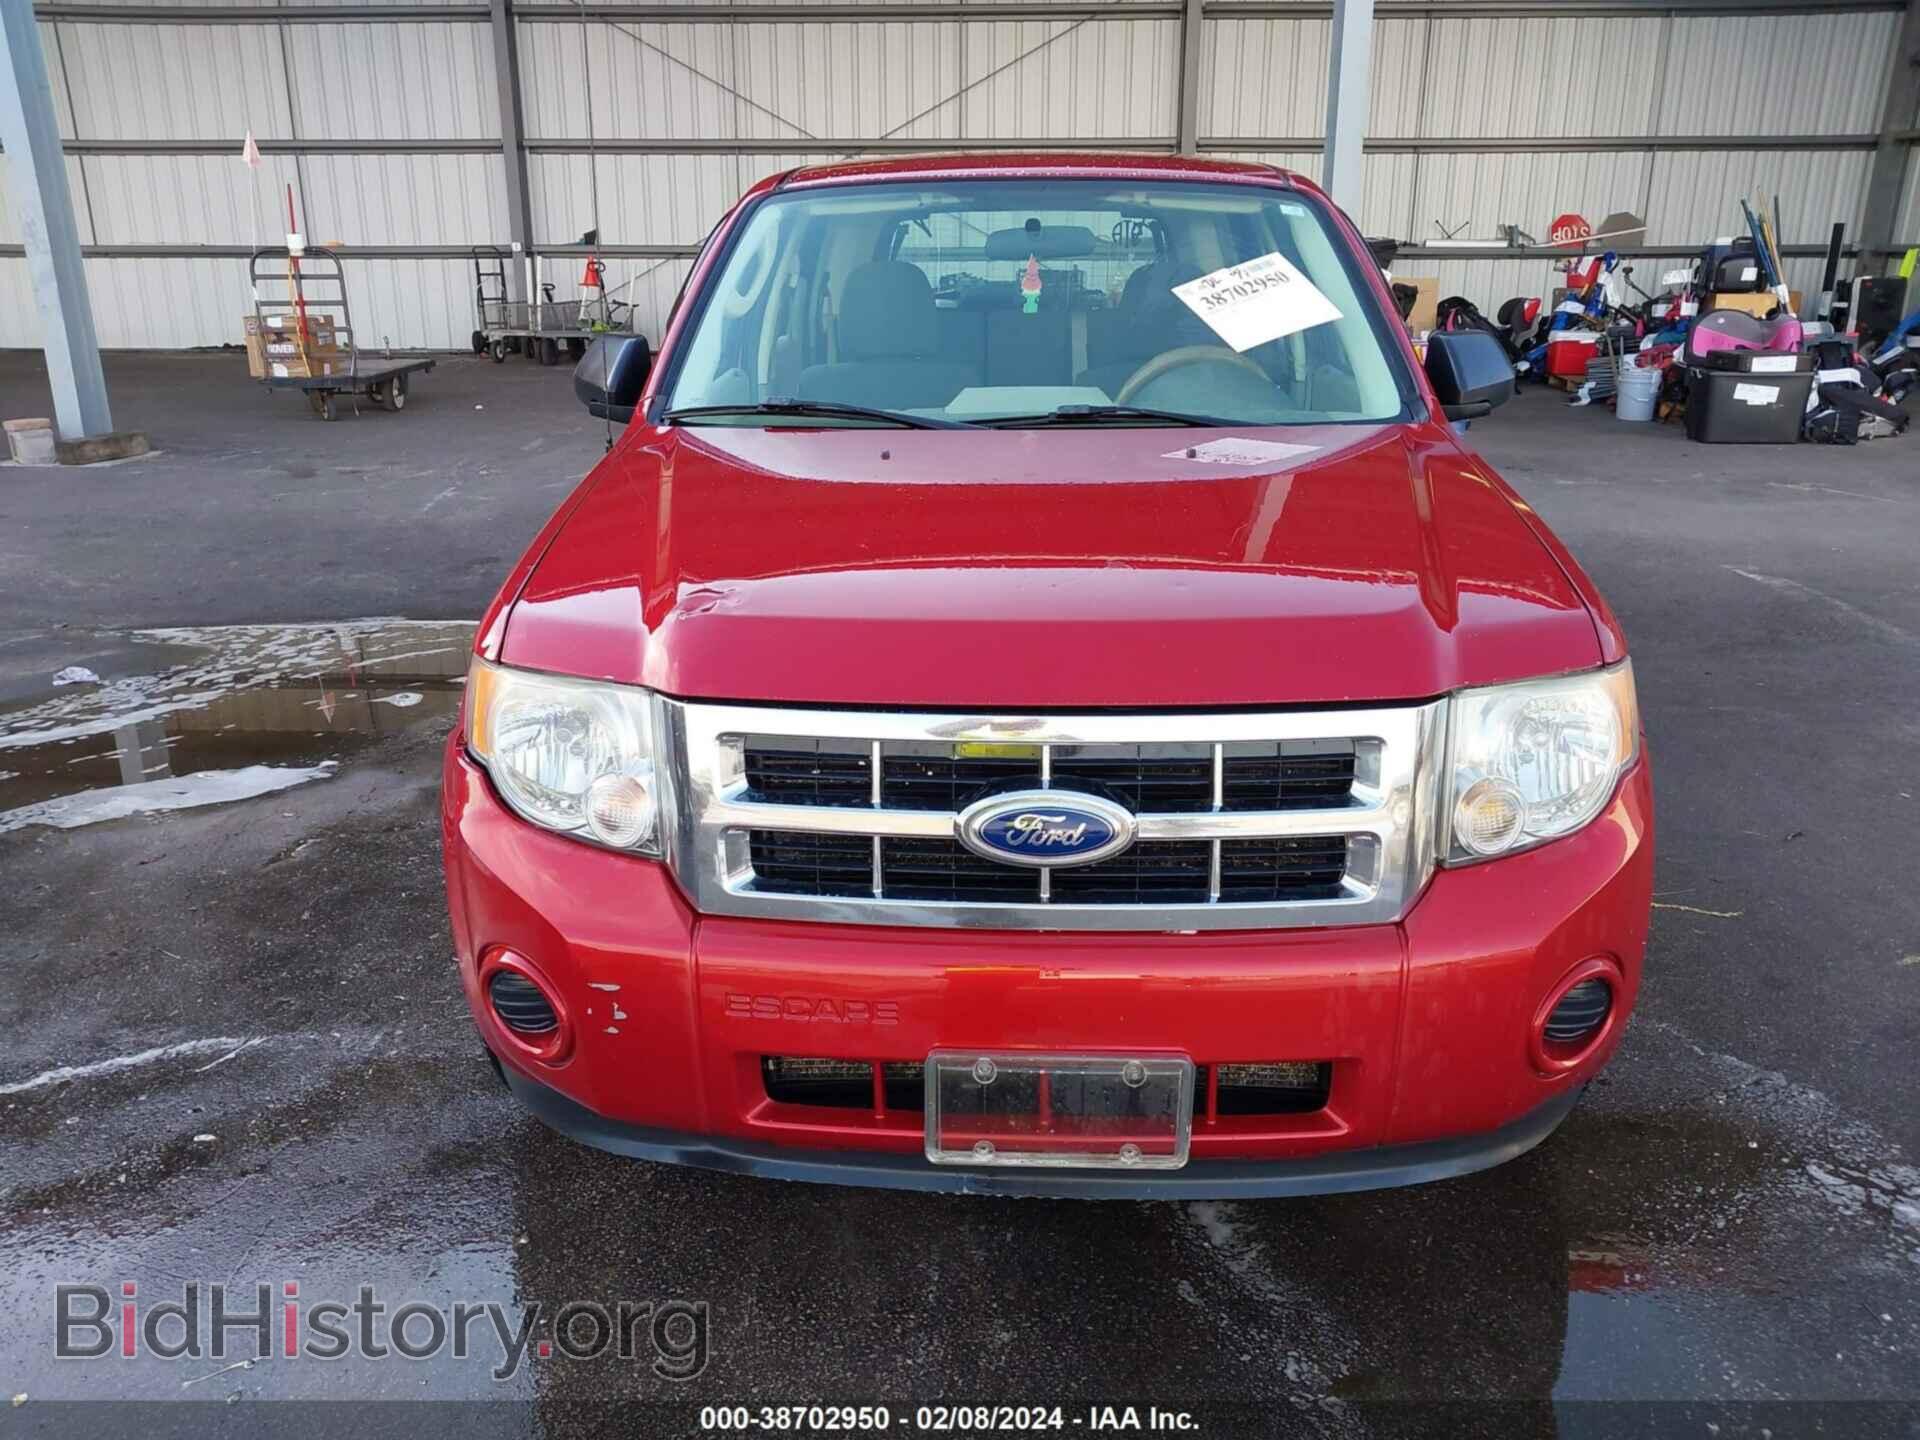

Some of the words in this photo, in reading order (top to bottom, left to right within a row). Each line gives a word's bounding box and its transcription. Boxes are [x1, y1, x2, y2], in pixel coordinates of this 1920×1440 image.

[1200, 271, 1290, 309] 38702950
[1006, 813, 1086, 847] Ford
[724, 992, 900, 1025] ESCAPE
